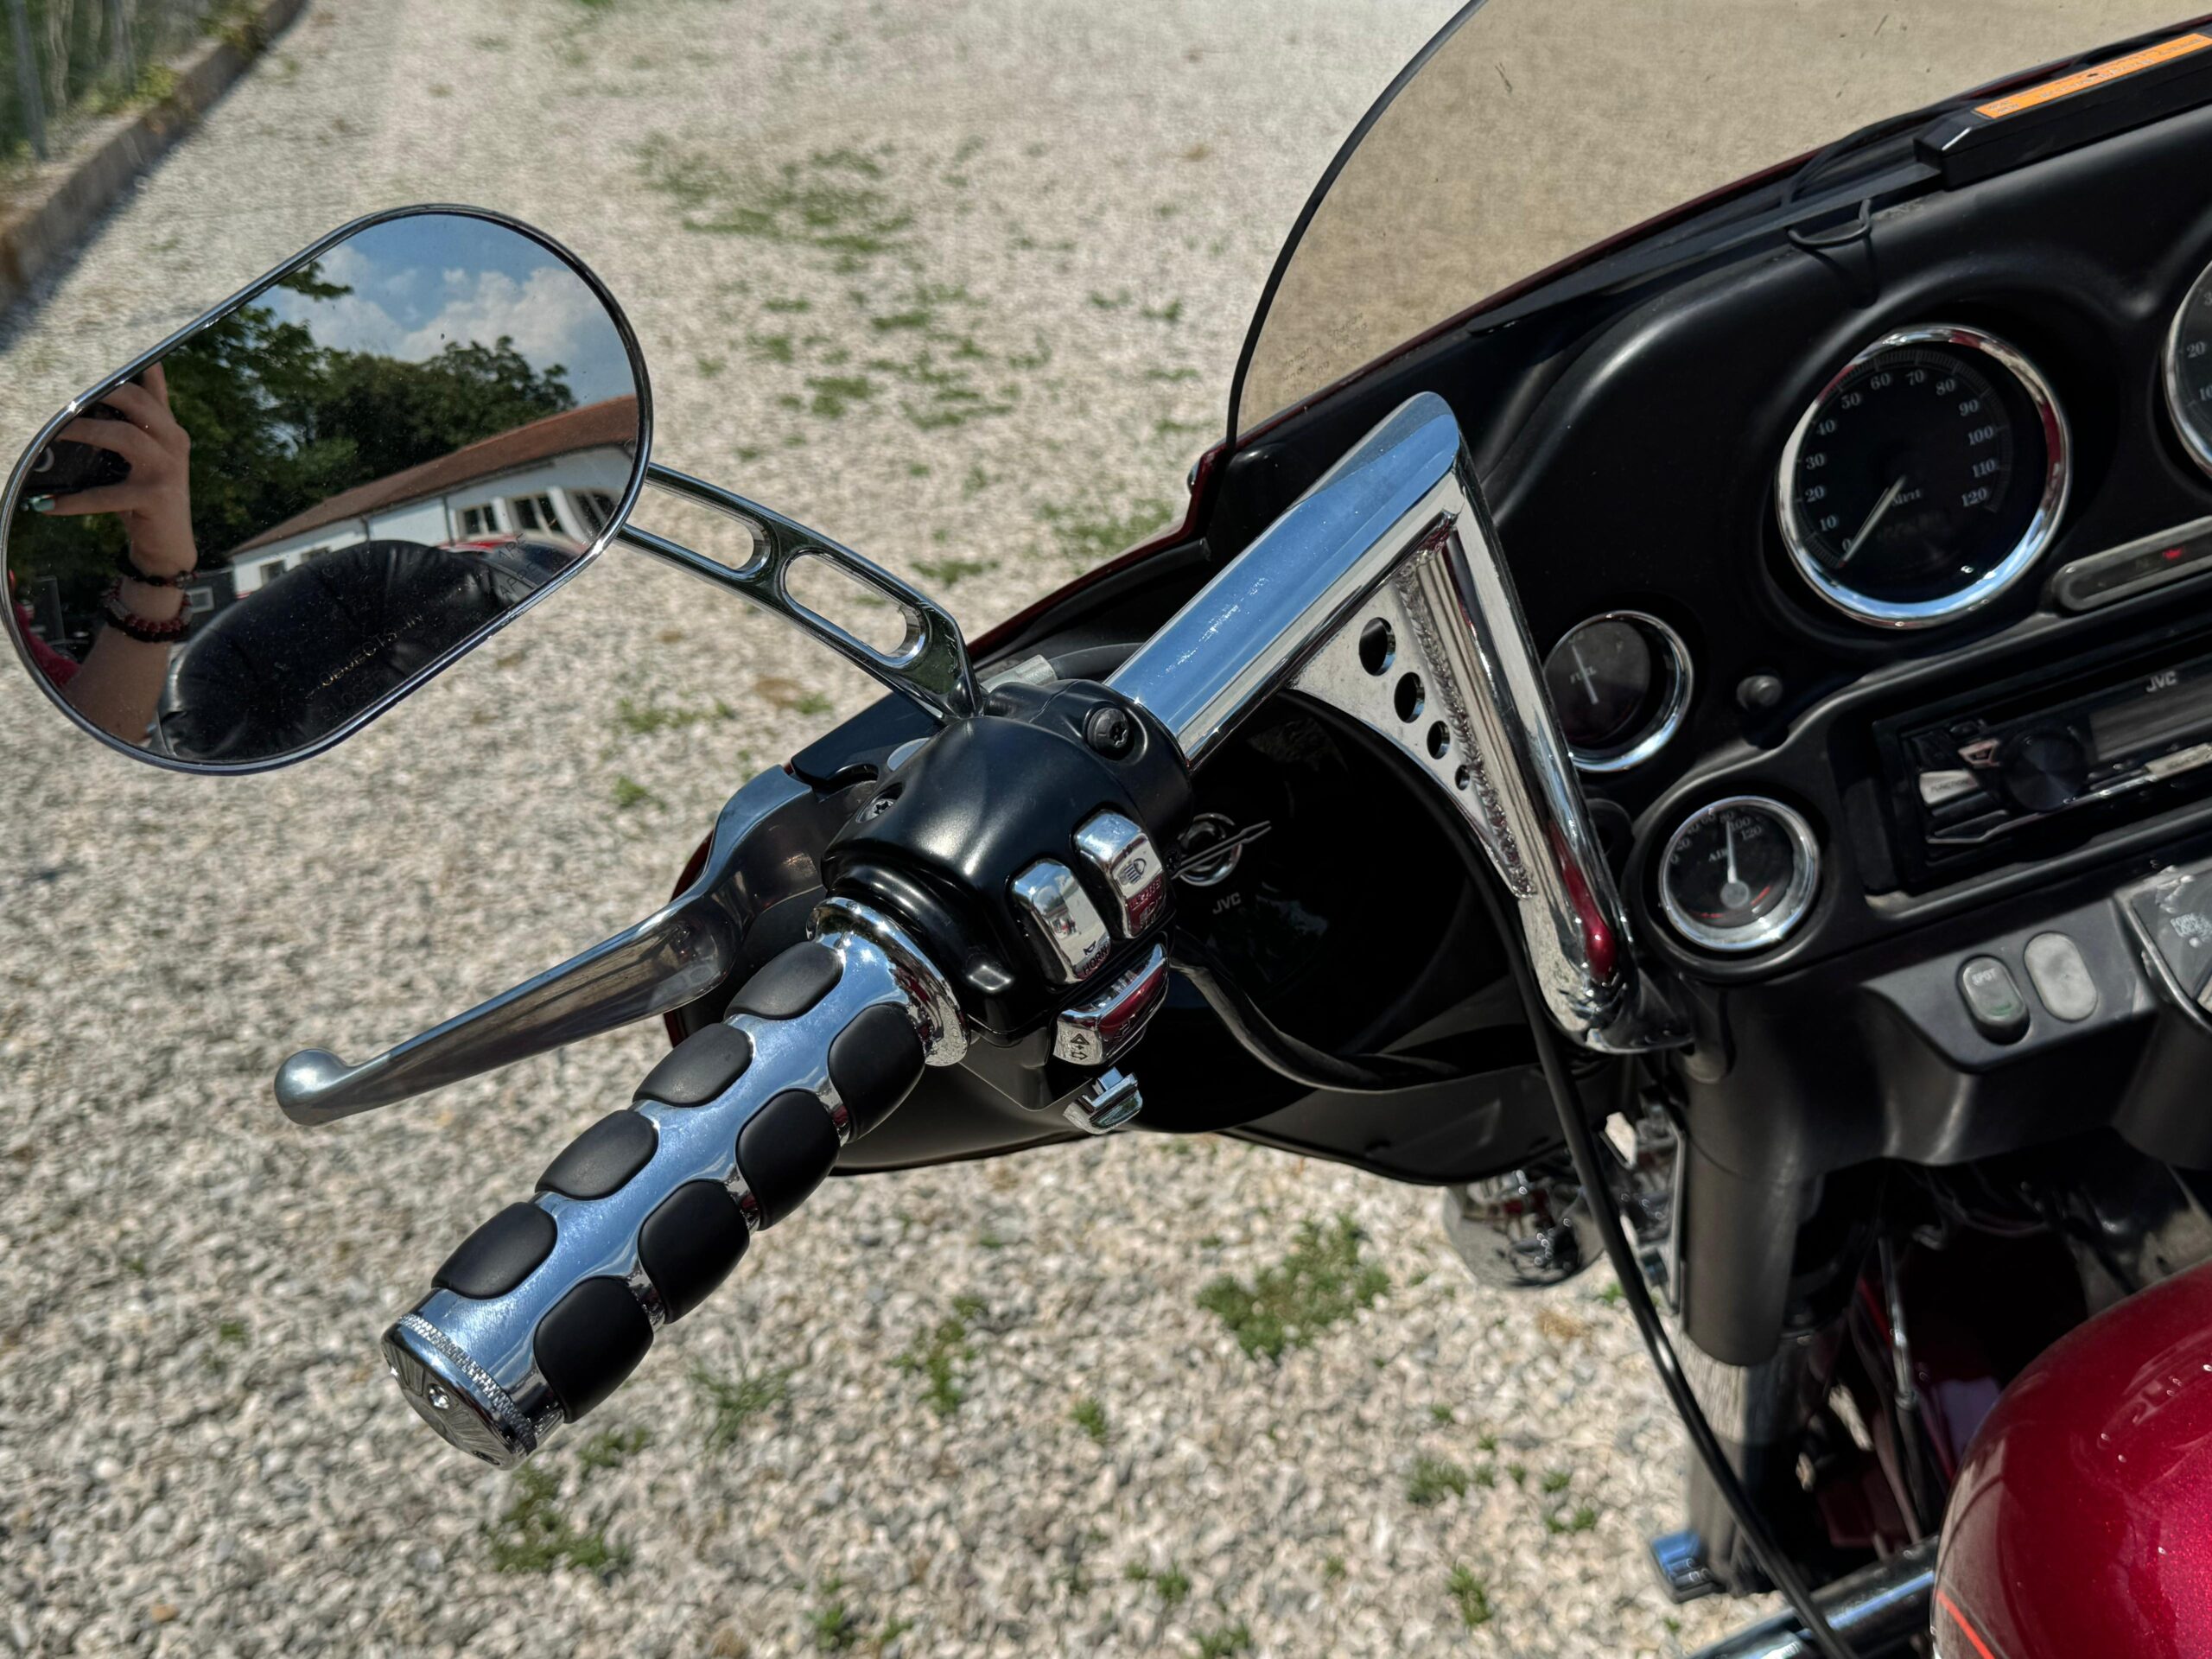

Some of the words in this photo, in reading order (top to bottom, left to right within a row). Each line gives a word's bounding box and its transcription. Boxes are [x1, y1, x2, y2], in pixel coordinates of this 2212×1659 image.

[2186, 341, 2206, 359] 20
[1870, 374, 1892, 391] 60
[1906, 369, 1926, 385] 70
[1936, 378, 1957, 397] 80
[1840, 391, 1862, 410] 50
[1958, 398, 1980, 417] 90
[1814, 418, 1837, 436] 40
[1967, 425, 1994, 446] 100
[1805, 453, 1827, 469] 30
[1972, 458, 1999, 480] 110
[1804, 486, 1827, 504] 20
[1961, 486, 1989, 508] 120
[1818, 515, 1840, 533] 10
[1841, 538, 1853, 552] 0
[318, 627, 399, 687] OBJECTS
[2145, 671, 2178, 693] JVC
[1740, 824, 1763, 841] 120
[1211, 892, 1242, 915] JVC
[1083, 943, 1109, 976] HORN
[1971, 968, 1998, 987] SPOT
